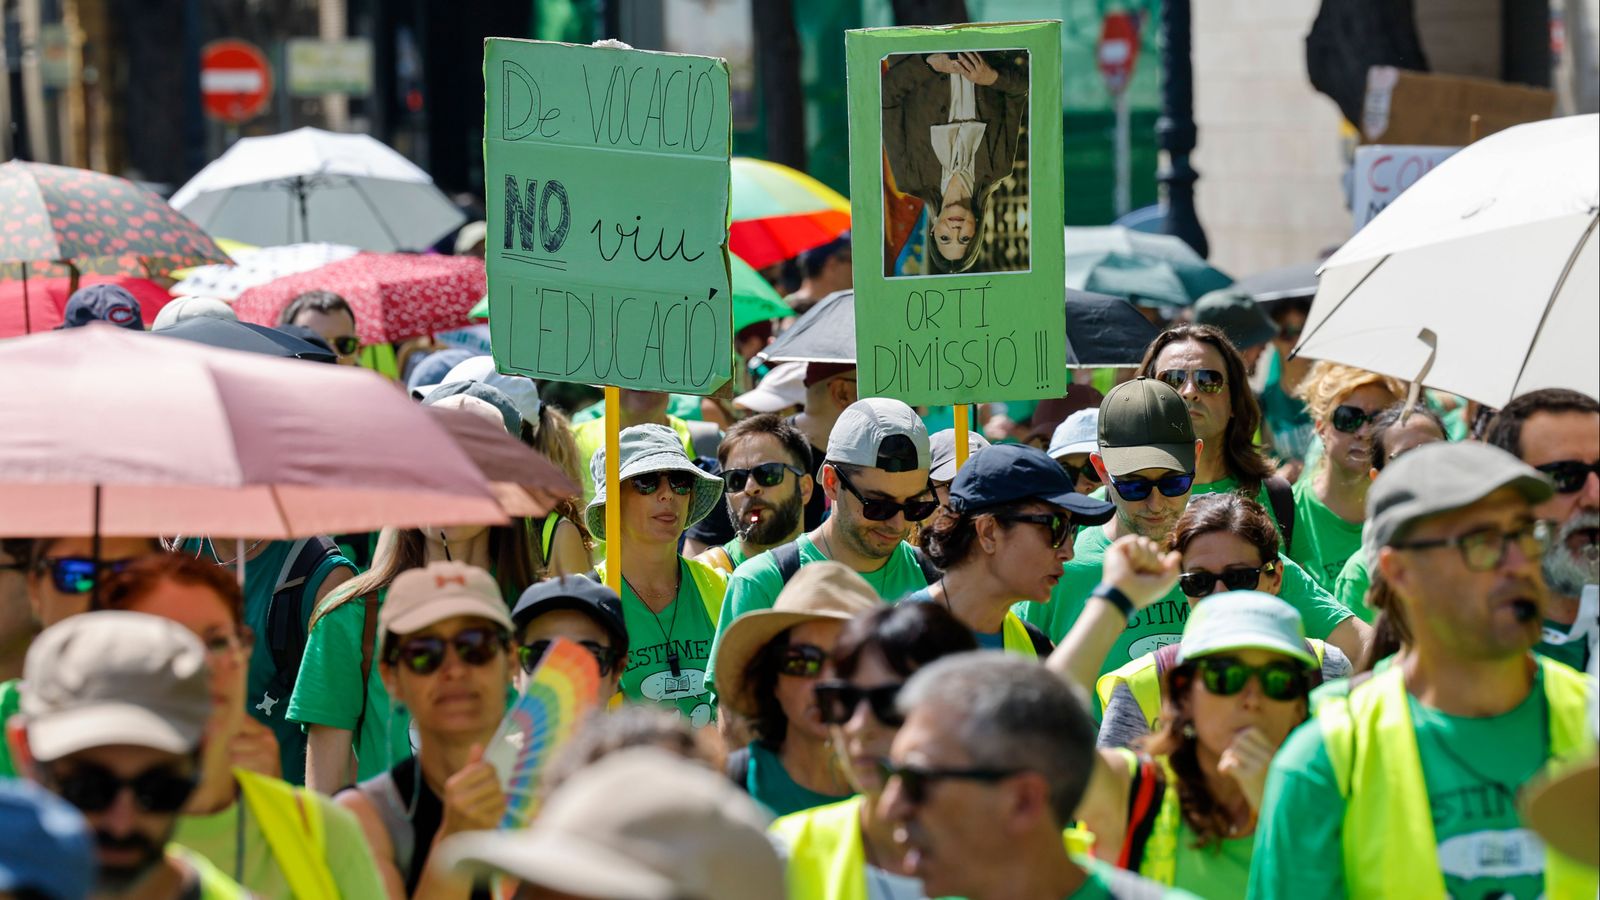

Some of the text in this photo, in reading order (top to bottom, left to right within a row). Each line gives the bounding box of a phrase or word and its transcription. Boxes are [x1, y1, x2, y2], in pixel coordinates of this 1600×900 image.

[502, 59, 561, 141] De
[1367, 155, 1434, 193] CO
[504, 174, 705, 262] NO viu
[906, 280, 992, 331] ORTÍ
[625, 638, 712, 672] ESTIME
